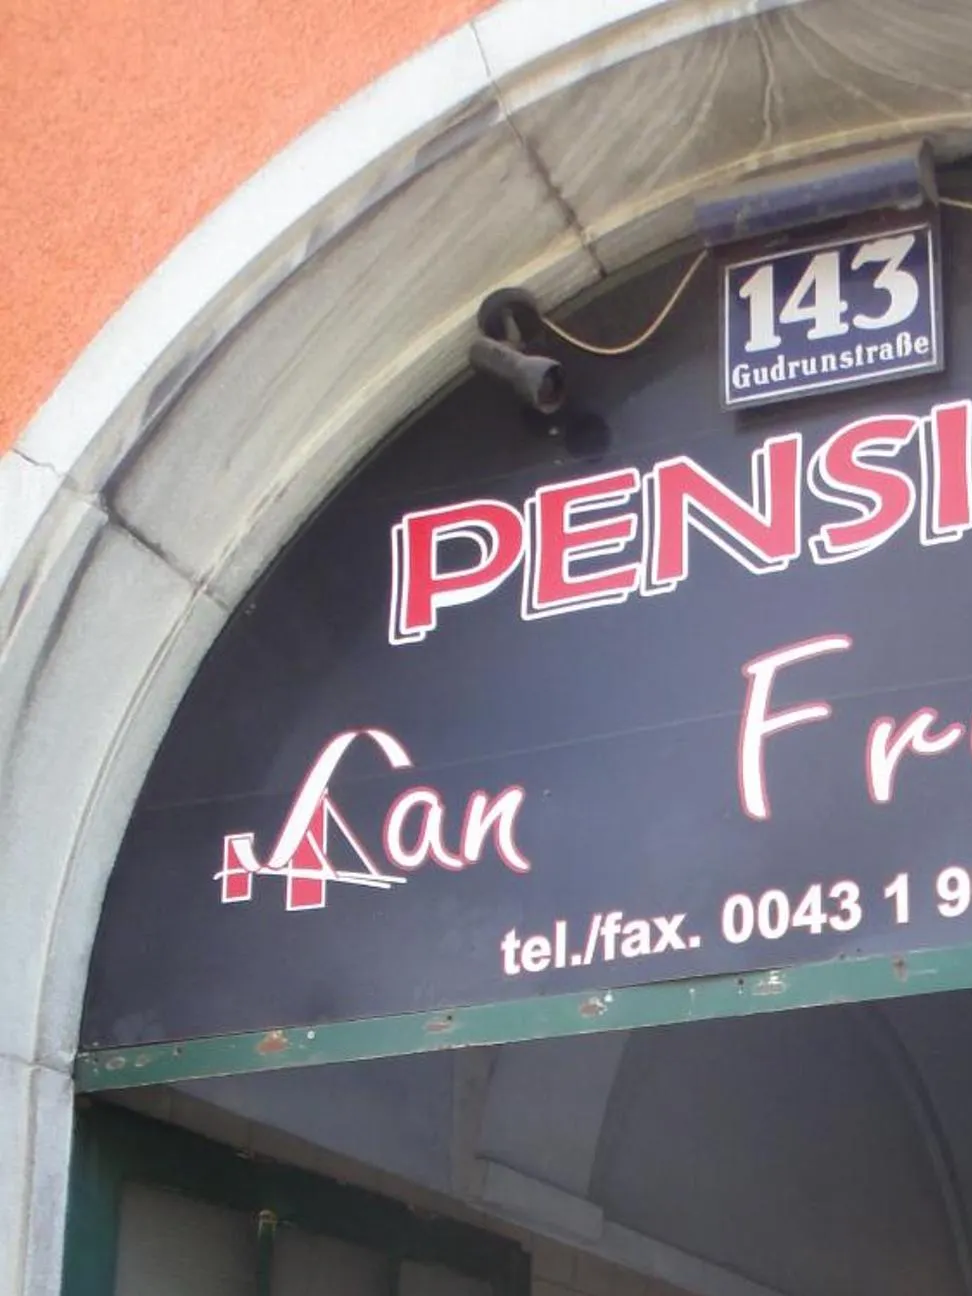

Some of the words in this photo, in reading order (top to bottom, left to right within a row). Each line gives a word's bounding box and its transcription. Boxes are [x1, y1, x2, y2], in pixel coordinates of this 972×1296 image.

[739, 234, 919, 352] 143
[731, 331, 931, 389] Gudrunstraße
[500, 908, 703, 978] tel./fax.
[721, 878, 863, 946] 0043
[886, 867, 911, 927] 1
